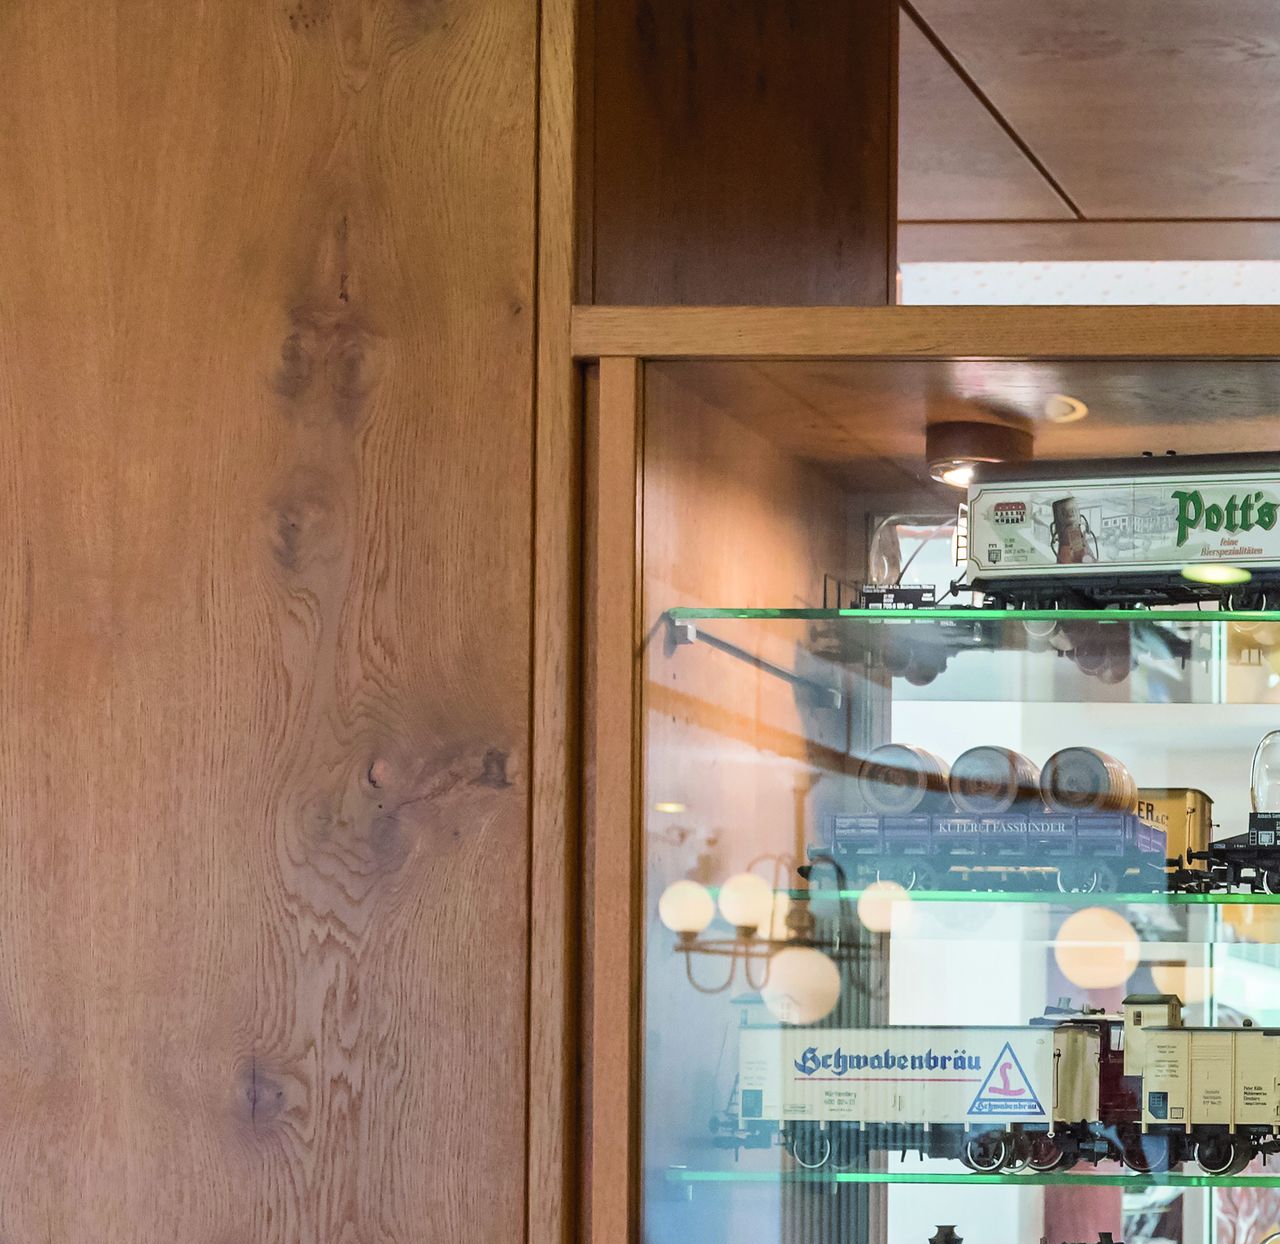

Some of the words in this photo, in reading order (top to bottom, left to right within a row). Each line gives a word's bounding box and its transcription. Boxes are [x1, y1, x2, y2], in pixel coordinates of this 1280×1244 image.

[1171, 490, 1280, 547] Pott's
[1219, 536, 1239, 547] feine
[1200, 543, 1264, 557] Bierspezialitäten
[992, 822, 1066, 833] FASSBINDER
[794, 1047, 982, 1077] Schwabenbräu
[974, 1101, 1038, 1112] Schwabenbräu
